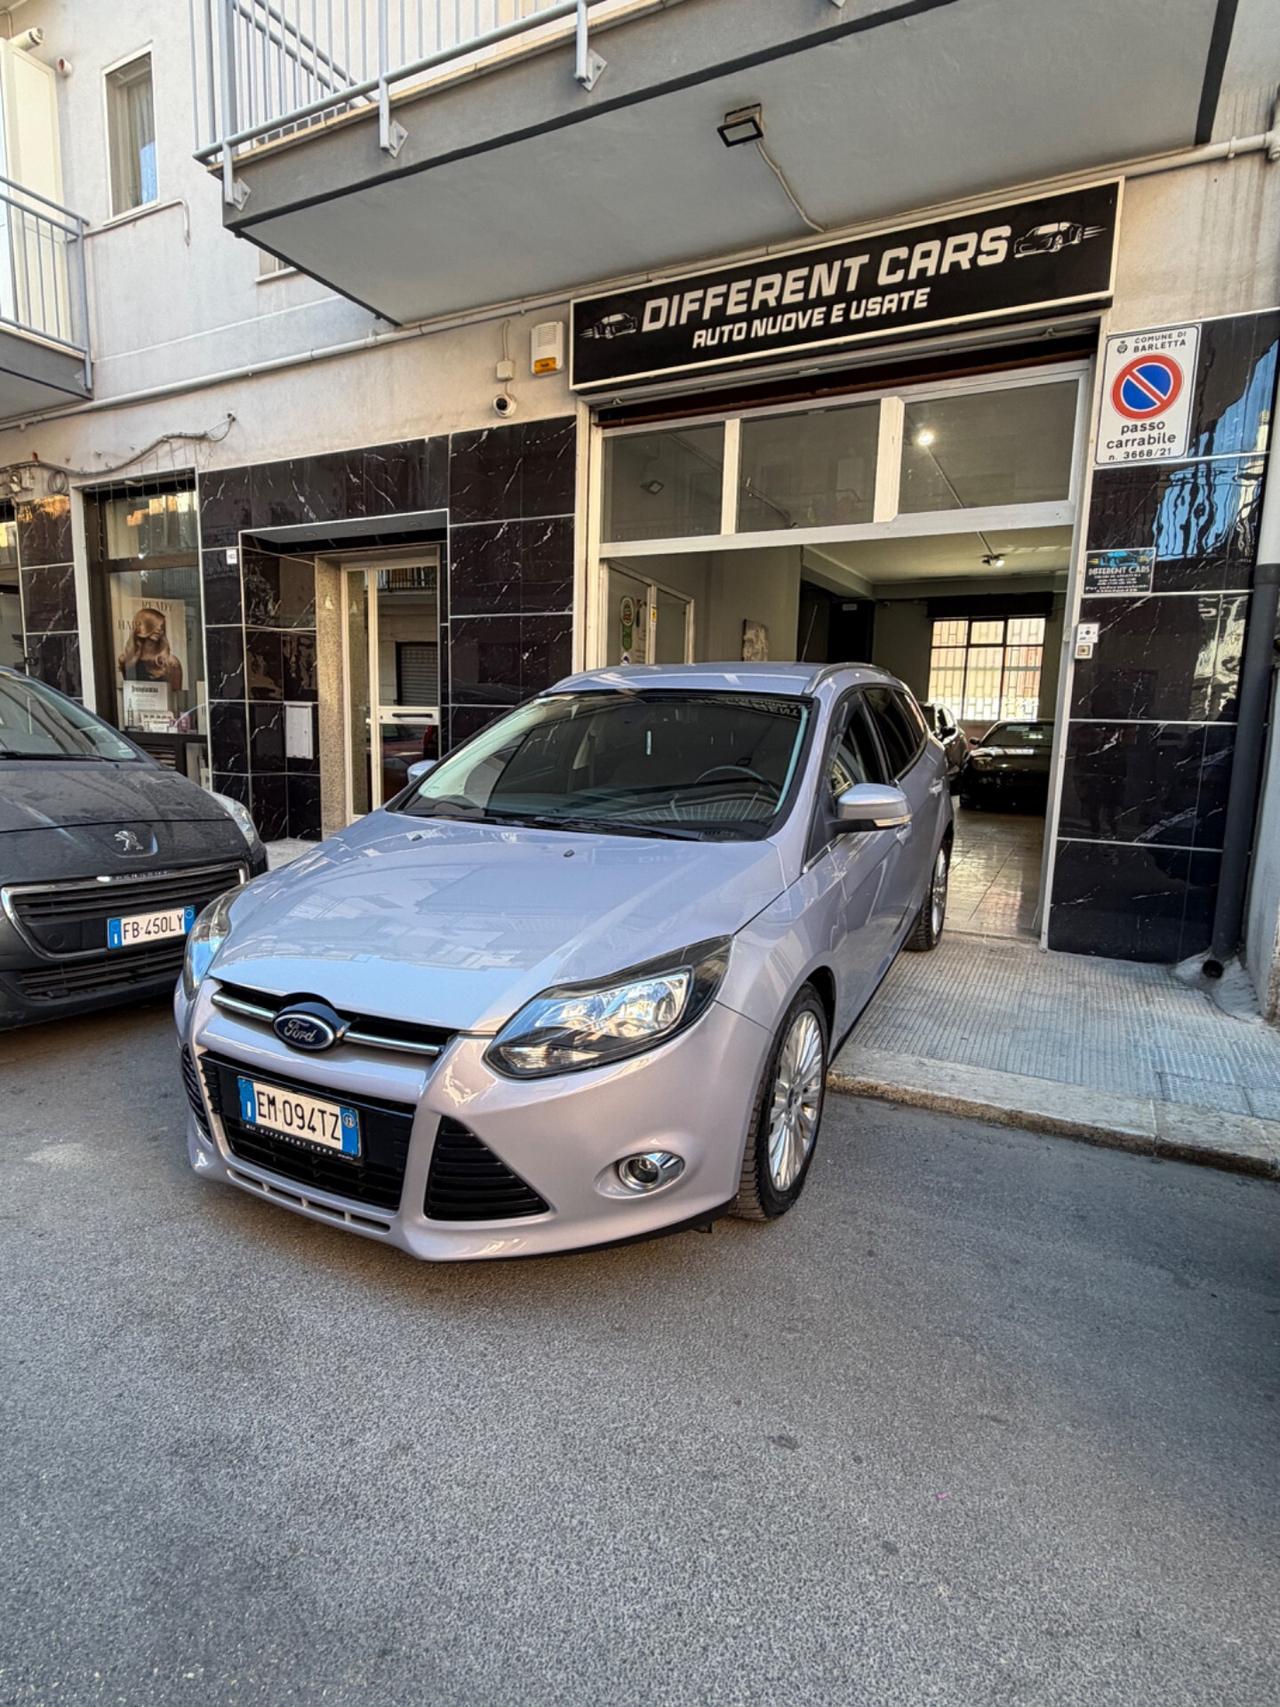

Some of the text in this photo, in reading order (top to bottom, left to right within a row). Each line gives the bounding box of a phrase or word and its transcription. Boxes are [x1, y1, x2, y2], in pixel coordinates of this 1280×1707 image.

[642, 225, 1012, 332] DIFFERENT CARS
[692, 287, 931, 349] AUTO NUOVE E USATE
[1133, 339, 1187, 353] BARLETTA
[1134, 333, 1173, 343] COMUNE
[1120, 420, 1165, 436] passo
[1106, 432, 1177, 450] carrabile
[1123, 447, 1172, 460] 3668/21
[123, 922, 139, 939] FB
[145, 914, 184, 935] 450LY
[283, 1018, 317, 1043] Ford
[256, 1090, 278, 1122] EM
[283, 1100, 340, 1141] 094TZ
